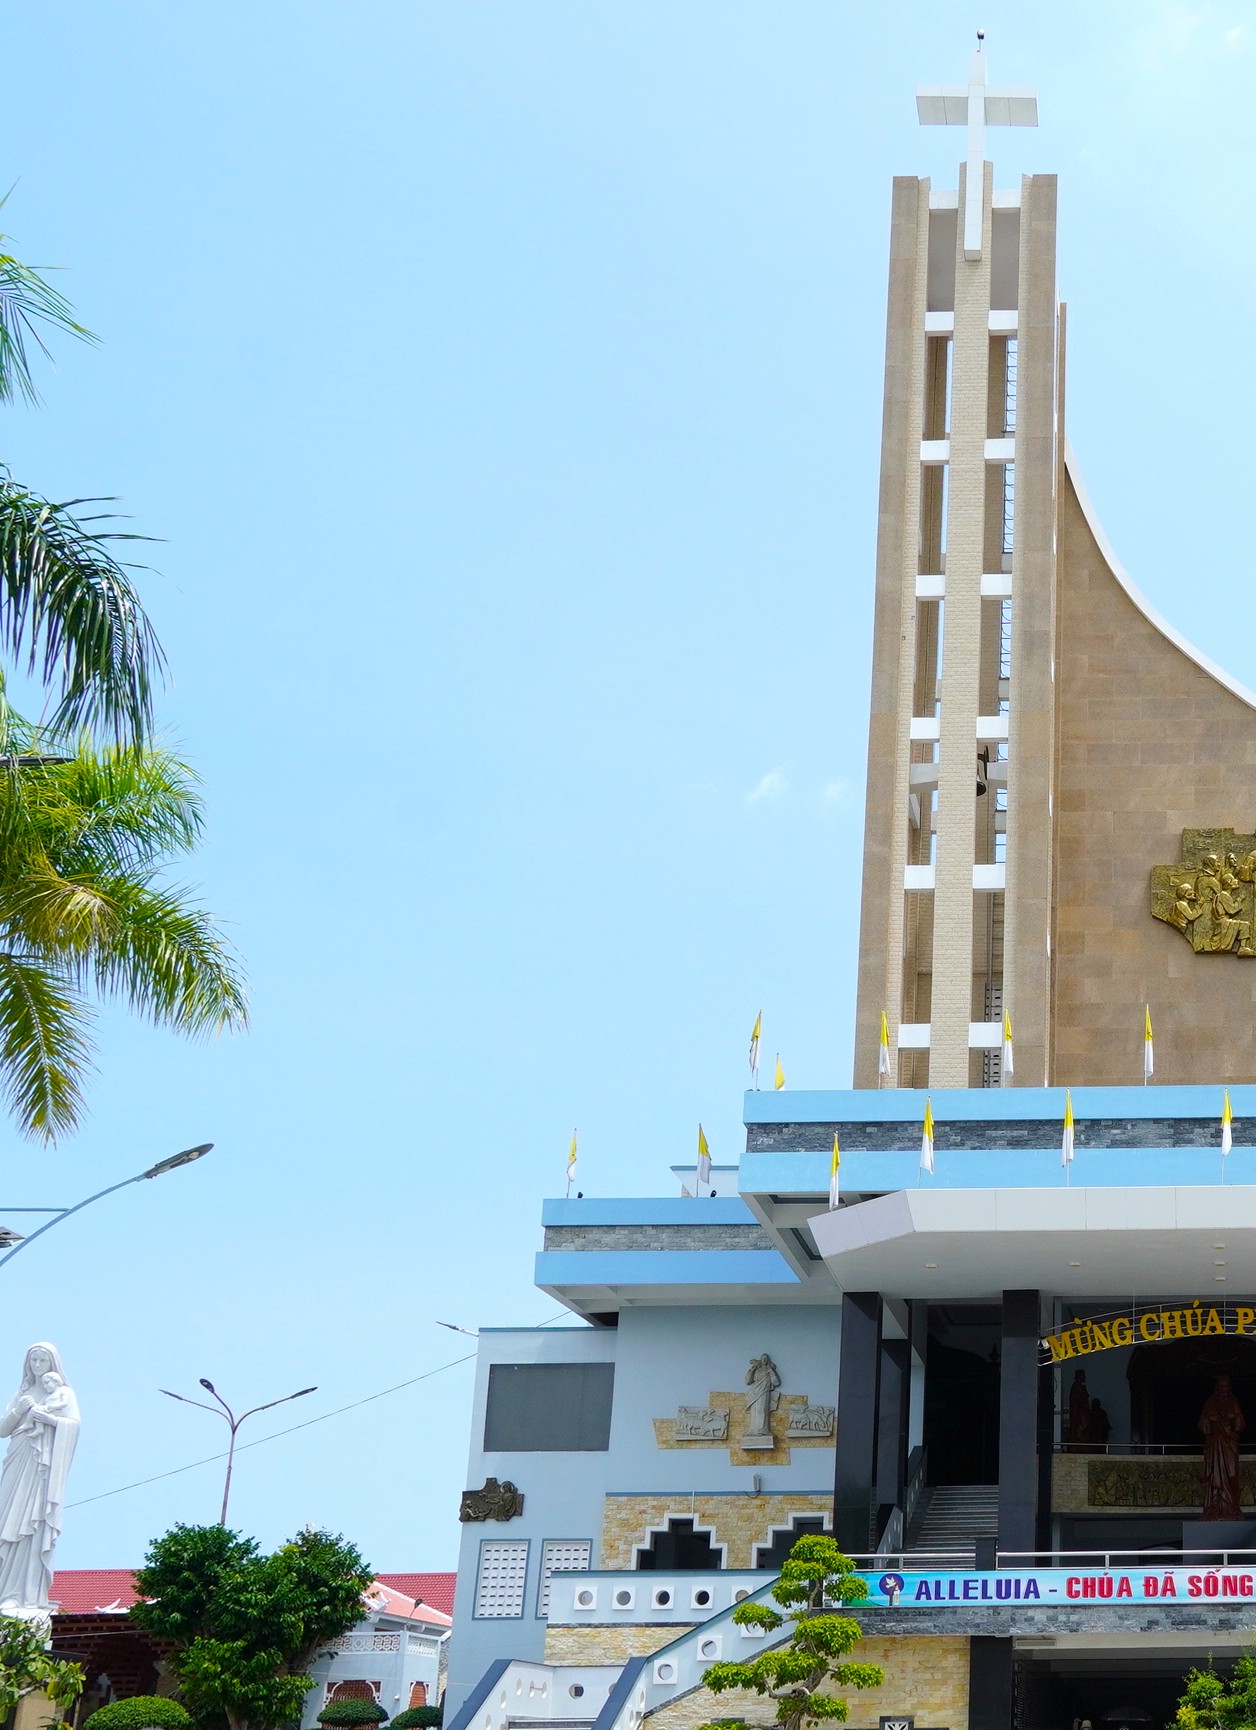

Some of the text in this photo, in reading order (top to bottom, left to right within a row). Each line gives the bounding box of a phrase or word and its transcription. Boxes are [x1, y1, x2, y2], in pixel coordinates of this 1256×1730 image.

[1046, 1317, 1133, 1362] MỪNG
[1140, 1299, 1225, 1342] CHÚA
[914, 1578, 1040, 1601] ALLELUIA
[1065, 1572, 1133, 1598] CHÚA
[1142, 1571, 1177, 1598] ĐÃ
[1187, 1568, 1253, 1597] SỐNG
